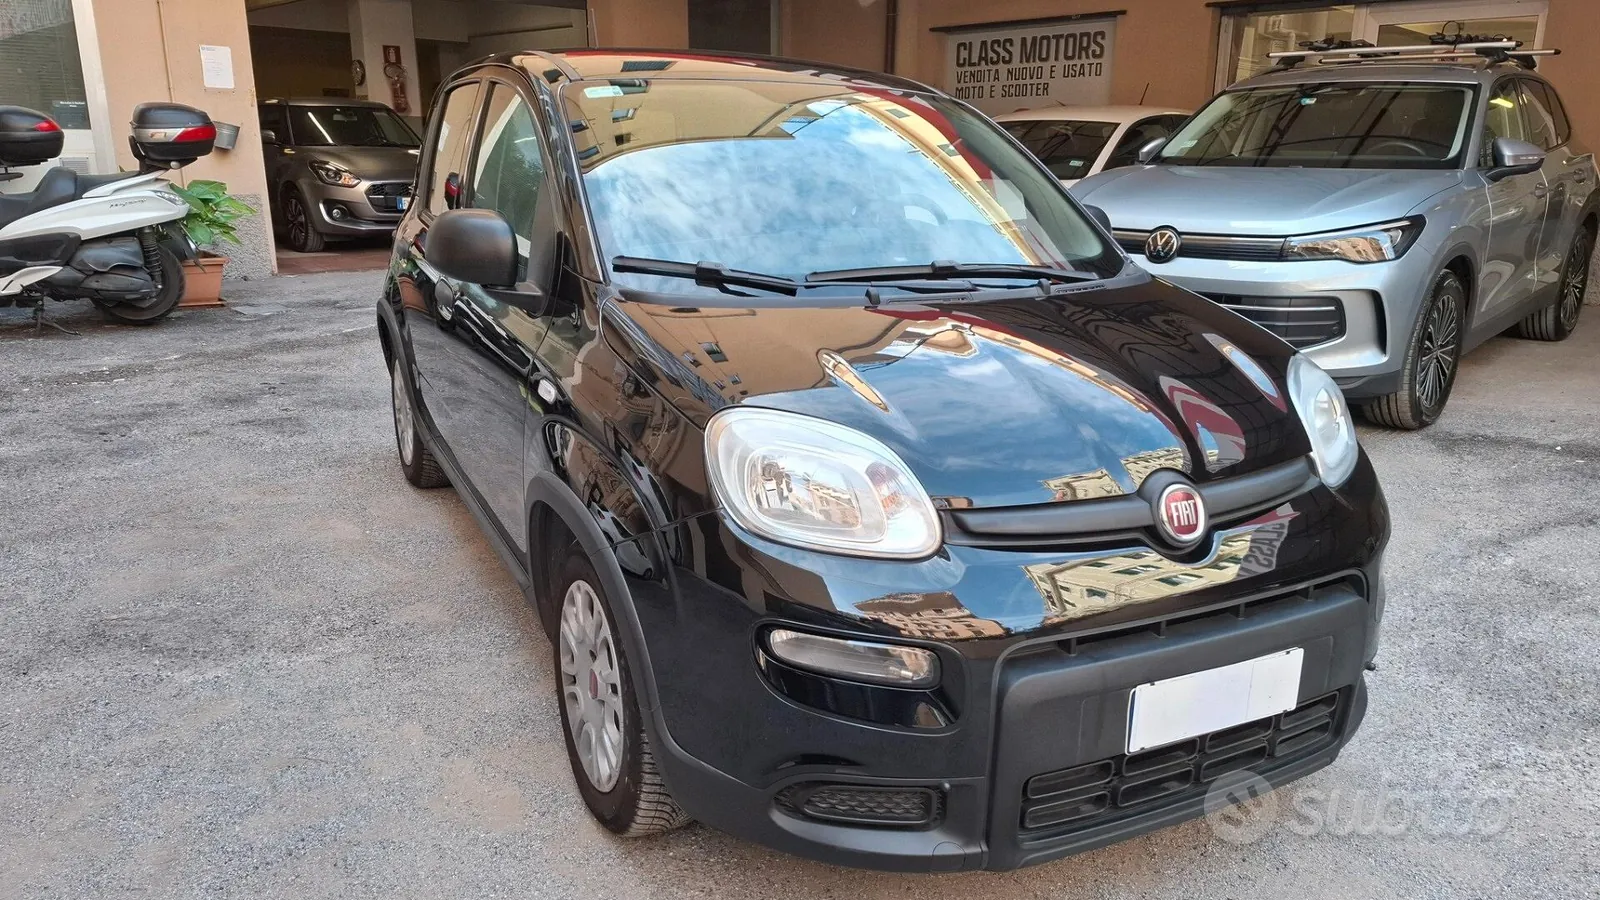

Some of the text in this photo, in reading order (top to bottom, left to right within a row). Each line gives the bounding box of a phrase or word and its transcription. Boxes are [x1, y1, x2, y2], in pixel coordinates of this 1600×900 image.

[956, 30, 1106, 67] CLASS MOTORS
[956, 62, 1102, 84] VENDITA NUOVO E USATO
[955, 82, 1049, 100] MOTO E SCOOTER
[1171, 500, 1197, 527] FIAT
